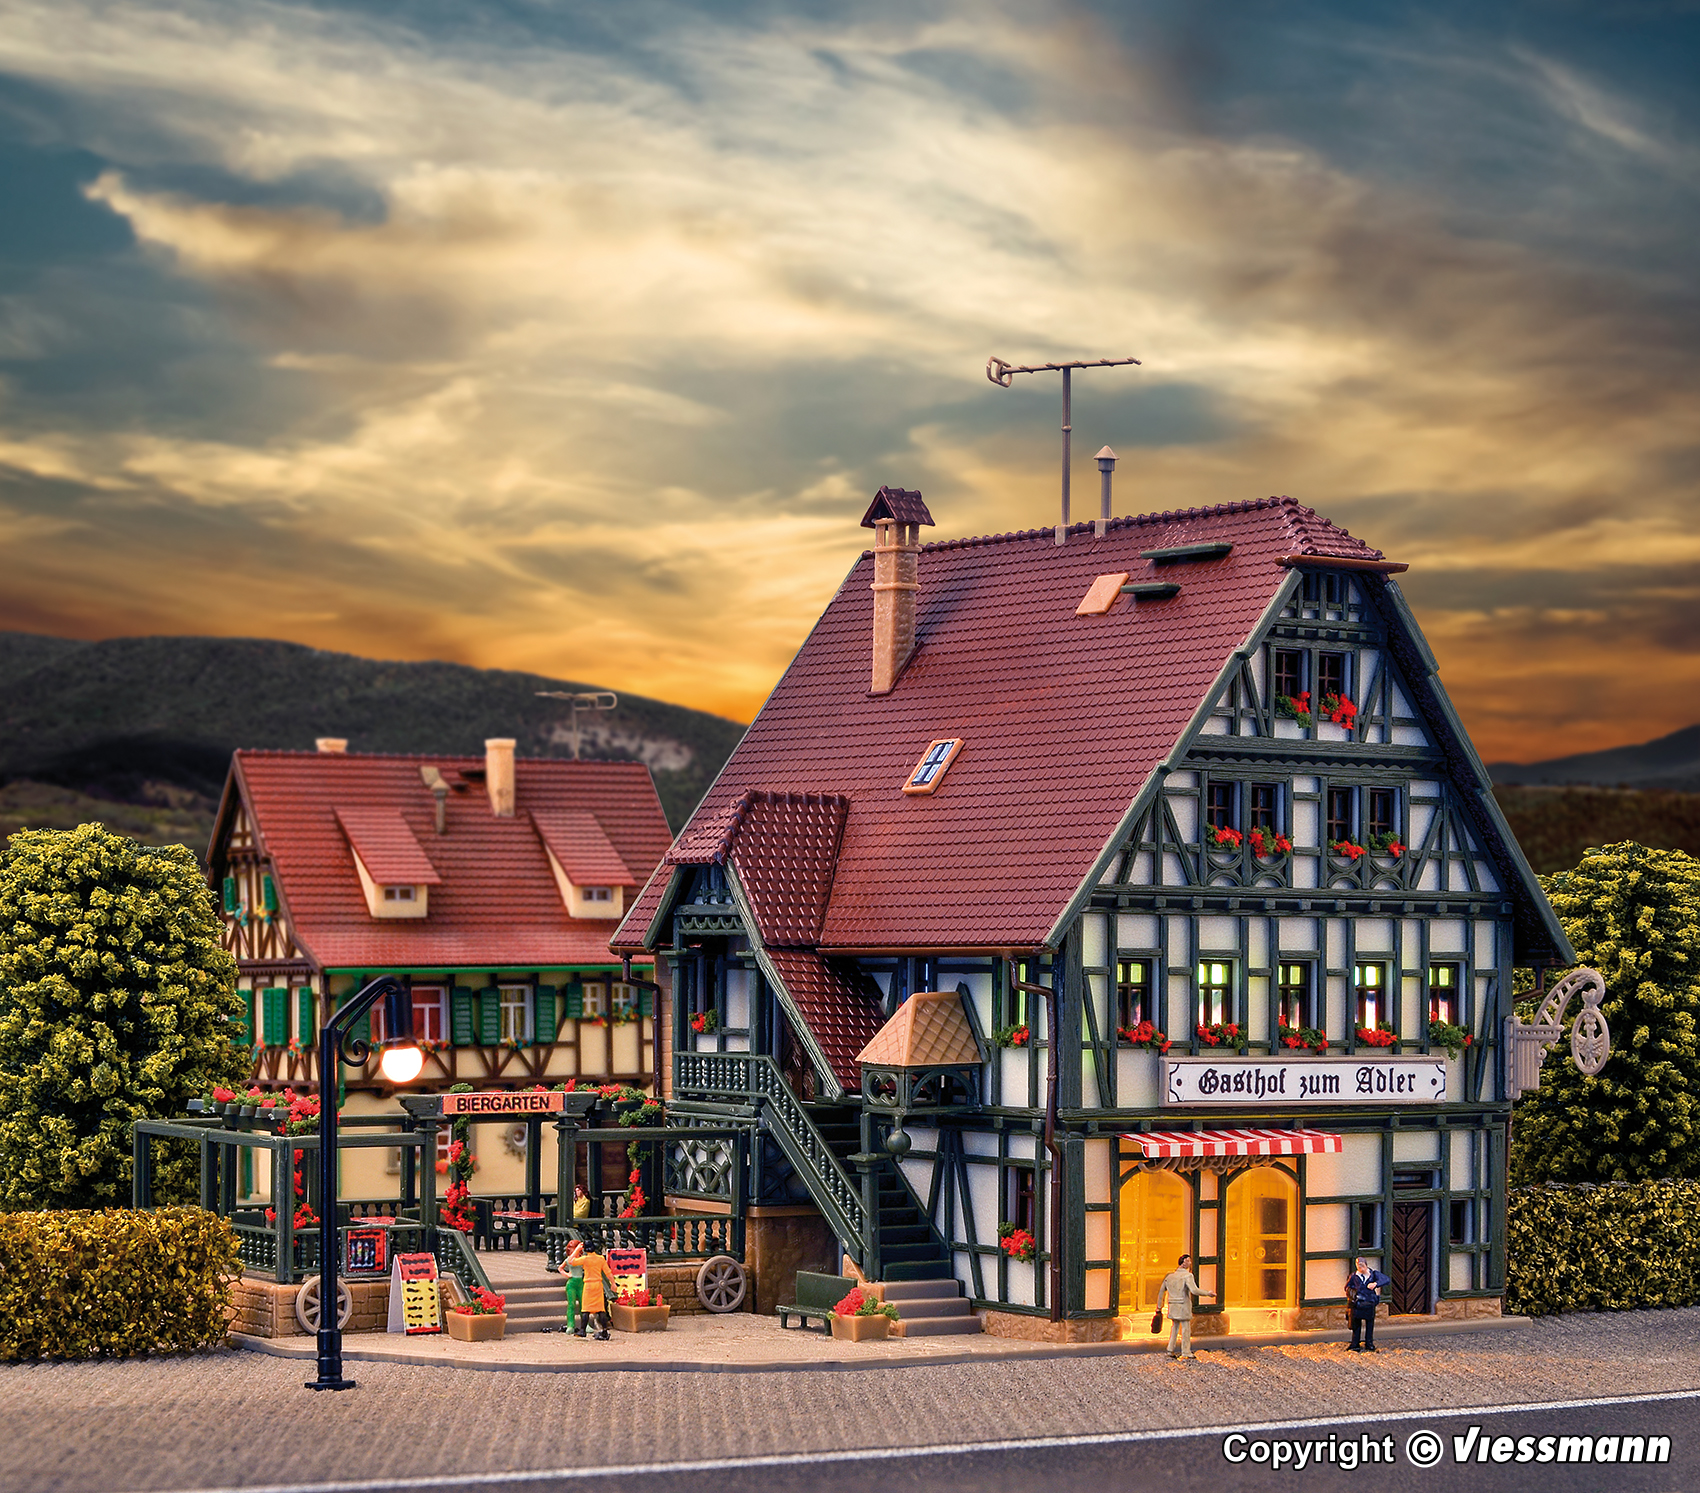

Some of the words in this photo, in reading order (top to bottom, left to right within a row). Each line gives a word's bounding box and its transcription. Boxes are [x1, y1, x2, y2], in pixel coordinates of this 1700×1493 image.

[1199, 1068, 1286, 1098] Gasthof
[1299, 1074, 1340, 1099] zum
[1355, 1066, 1416, 1093] Adler
[457, 1096, 549, 1112] BIERGARTEN
